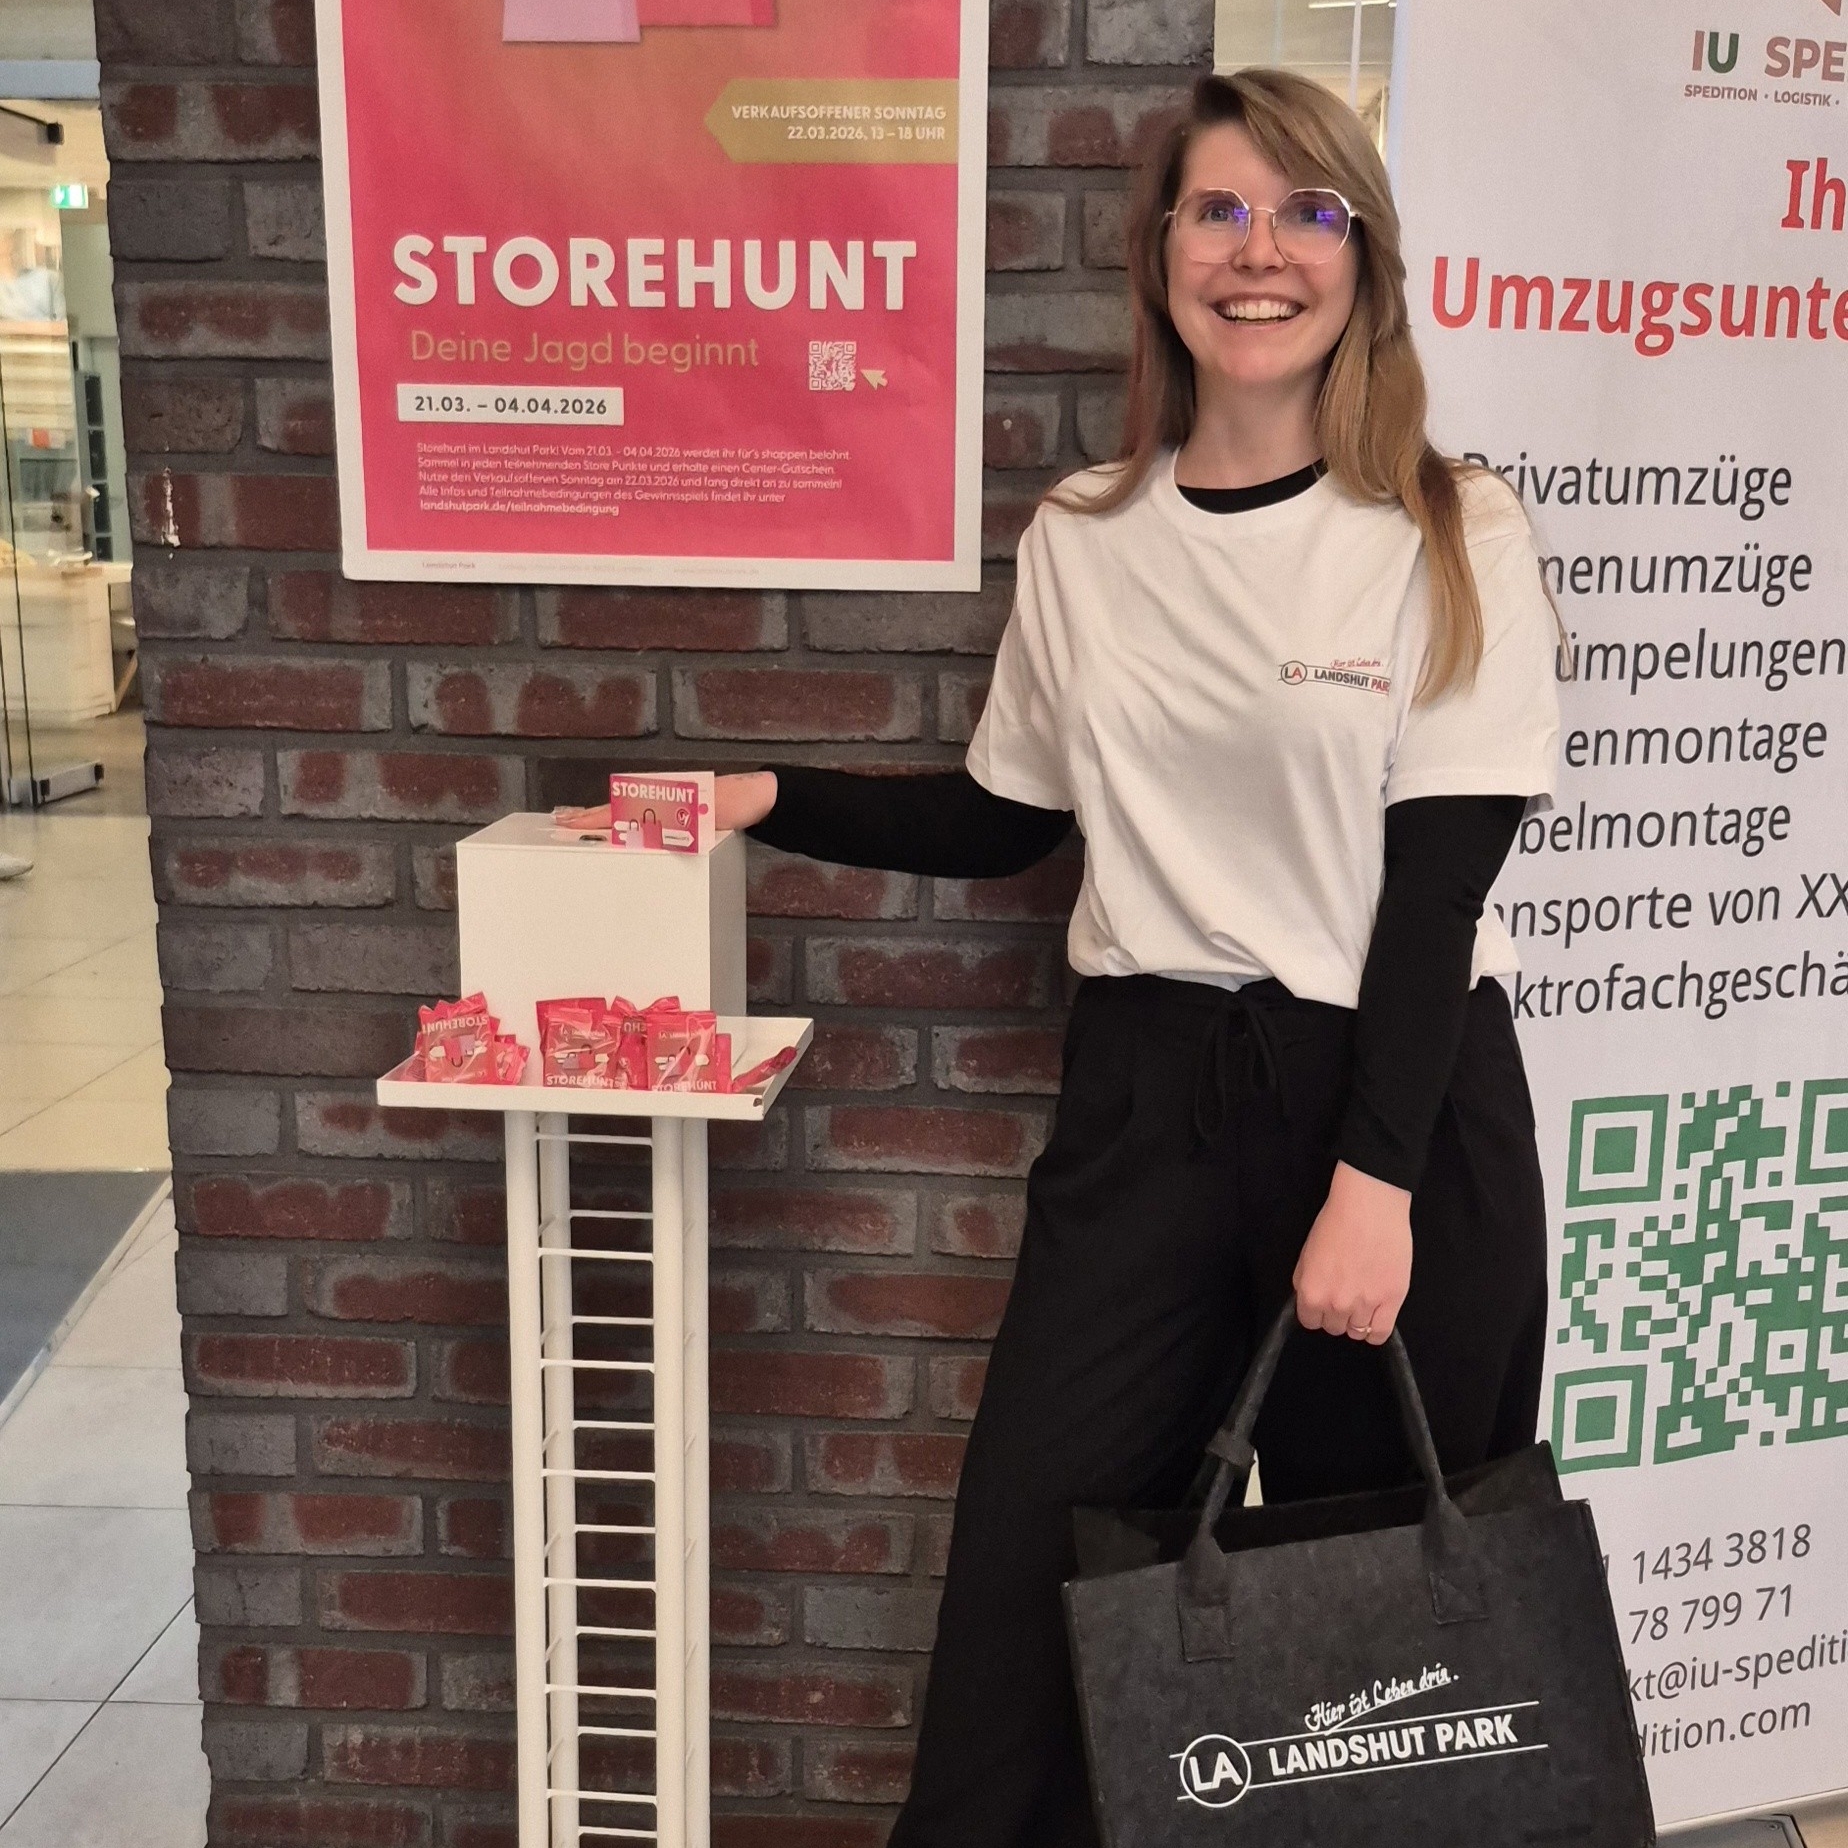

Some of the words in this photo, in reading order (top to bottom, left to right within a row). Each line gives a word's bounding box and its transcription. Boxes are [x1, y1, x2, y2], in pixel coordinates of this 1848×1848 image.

[1691, 30, 1739, 73] IU
[1764, 36, 1847, 82] SPE
[732, 105, 871, 119] VERKAUFSOFFENER
[874, 106, 946, 120] SONNTAG
[1684, 84, 1757, 101] SPEDITION
[1774, 90, 1831, 107] LOGISTIK
[787, 126, 868, 141] 22.03.2026,
[871, 126, 884, 139] 13
[898, 126, 912, 139] 18
[915, 126, 945, 140] UHR
[1781, 158, 1846, 231] Ih
[393, 235, 917, 311] STOREHUNT
[411, 330, 511, 361] Deine
[524, 332, 613, 371] Jagd
[624, 333, 759, 372] beginnt
[414, 396, 471, 412] 21.03.
[494, 398, 607, 415] 04.04.2026
[417, 443, 466, 454] Storehunt
[468, 444, 480, 454] im
[483, 444, 530, 455] Landshut
[624, 447, 680, 458] 04.04.2026
[683, 448, 719, 458] werdet
[722, 448, 735, 458] ihr
[762, 449, 808, 461] shoppen
[461, 459, 470, 468] in
[472, 459, 501, 471] jeden
[504, 460, 581, 470] teilnehmenden
[583, 460, 609, 471] Store
[612, 461, 647, 471] Punkte
[650, 462, 669, 472] und
[672, 462, 709, 472] erhalte
[711, 463, 739, 473] einen
[419, 472, 448, 482] Nutze
[451, 472, 471, 482] den
[561, 475, 604, 486] Sonntag
[606, 477, 623, 486] am
[625, 476, 679, 487] 22.03.2026
[681, 477, 701, 487] und
[703, 477, 728, 489] fang
[731, 478, 760, 488] direkt
[419, 486, 438, 497] Alle
[440, 486, 465, 497] Infos
[468, 487, 487, 497] und
[490, 487, 611, 500] Teilnahmebedingungen
[614, 490, 632, 499] des
[711, 491, 740, 502] findet
[743, 492, 756, 502] ihr
[758, 493, 786, 502] unter
[420, 500, 619, 516] landshutpark.de/teilnahmebedingung
[1538, 543, 1812, 607] menumzüge
[1285, 666, 1303, 679] LA
[1314, 669, 1370, 687] LANDSHUT
[1371, 678, 1390, 692] PAR
[1555, 627, 1846, 695] ümpelungen
[1565, 717, 1827, 773] enmontage
[612, 781, 694, 804] STOREHUNT
[1519, 801, 1791, 857] belmontage
[1494, 886, 1692, 949] nsporte
[1708, 885, 1780, 926] von
[1796, 873, 1848, 919] XX
[1513, 950, 1848, 1020] ktrofachgeschä
[421, 1016, 488, 1035] STOREHUNT
[1633, 1537, 1713, 1584] 1434
[1723, 1523, 1812, 1568] 3818
[1628, 1606, 1668, 1644] 78
[1681, 1592, 1742, 1635] 799
[1755, 1584, 1793, 1621] 71
[1626, 1629, 1848, 1702] kt@iu-spediti
[1305, 1701, 1345, 1732] Hier
[1349, 1689, 1371, 1715] ist
[1373, 1677, 1416, 1705] Leben
[1639, 1701, 1811, 1759] ition.com
[1189, 1751, 1243, 1792] LA
[1268, 1726, 1426, 1777] LANDSHUT
[1435, 1713, 1518, 1753] PARK
